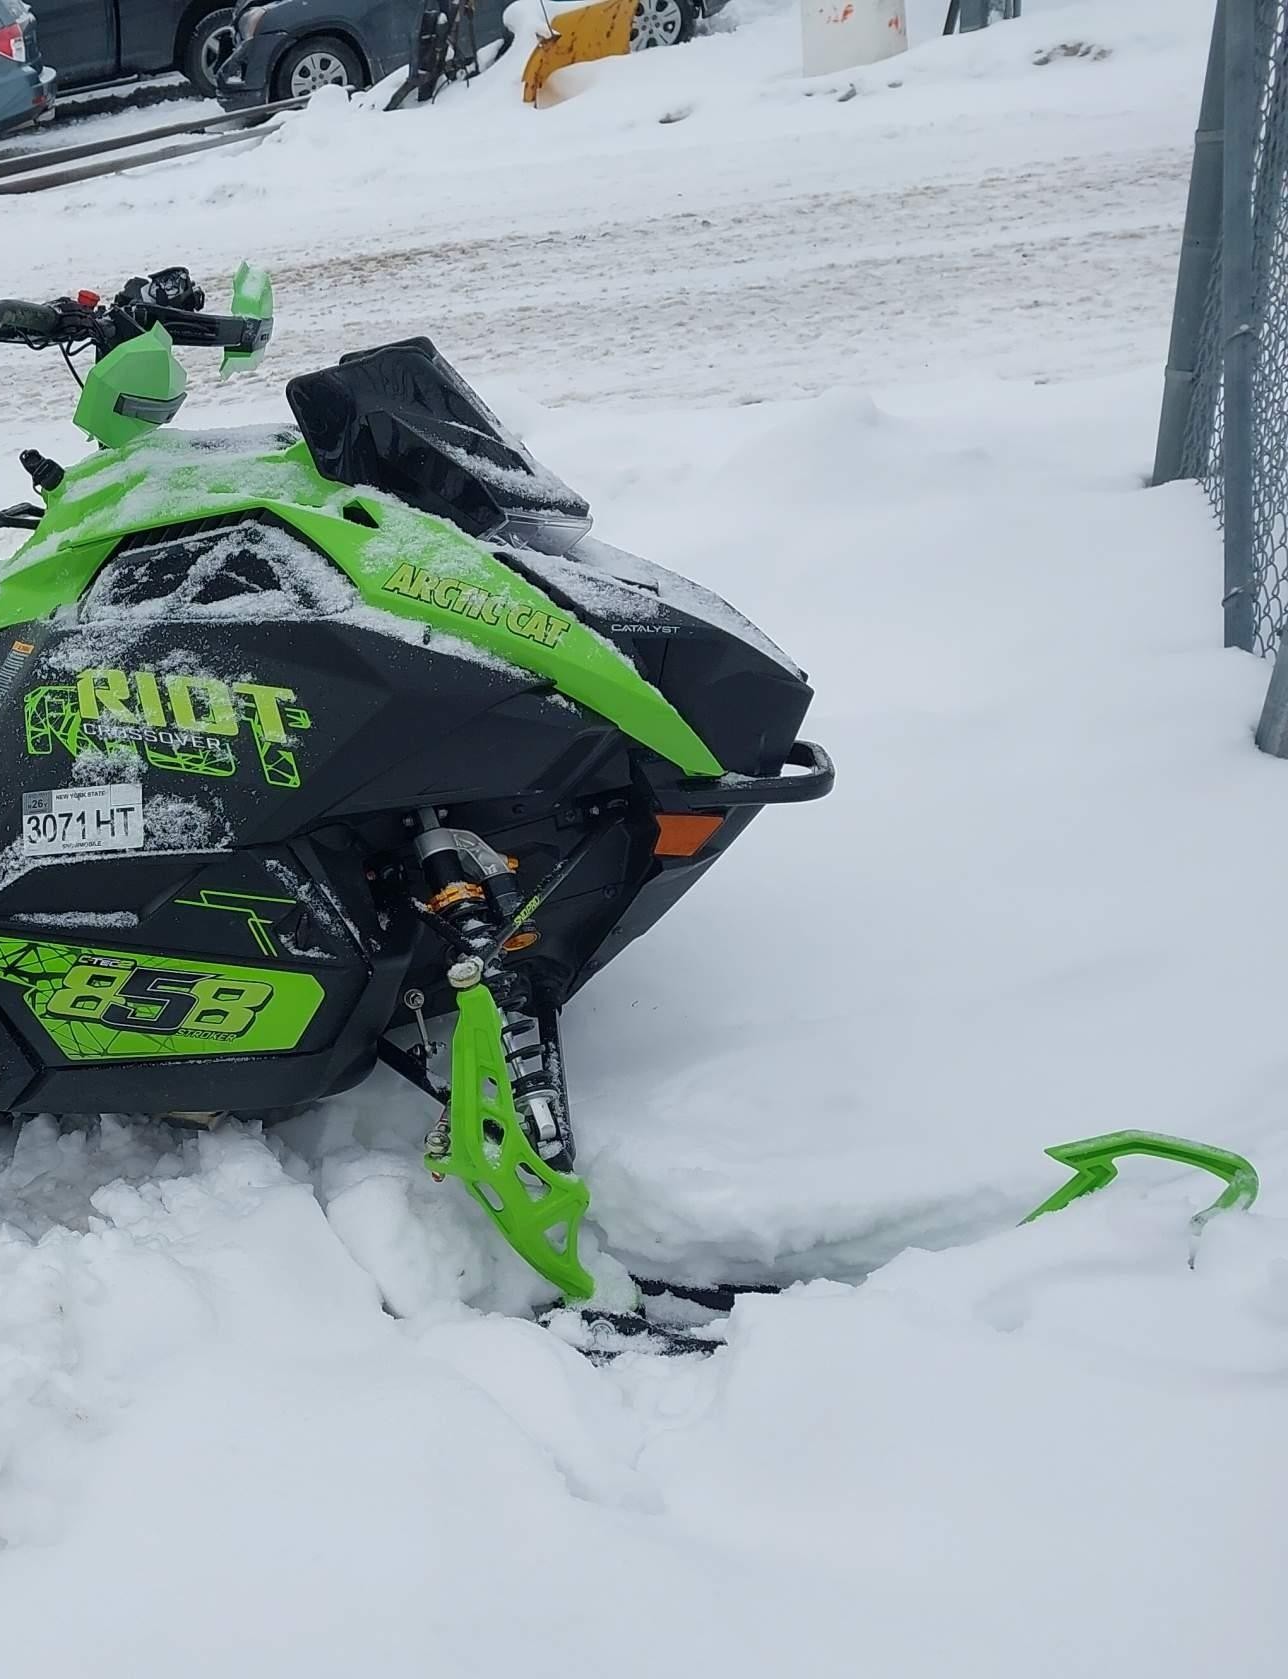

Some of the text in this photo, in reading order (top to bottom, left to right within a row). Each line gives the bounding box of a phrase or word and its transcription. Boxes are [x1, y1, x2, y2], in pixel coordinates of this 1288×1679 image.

[382, 562, 572, 649] ARCTIC CAT
[611, 623, 681, 634] CATALYST
[76, 669, 297, 744] RIOT
[83, 722, 221, 751] CROSSOVER
[32, 799, 43, 809] 26
[55, 793, 69, 801] NEW
[70, 791, 87, 800] YORK
[87, 790, 105, 798] STATE
[27, 806, 135, 844] 3071 HT
[78, 954, 135, 970] C-TEC2
[46, 965, 274, 1036] 858
[175, 1028, 238, 1042] STROKER
